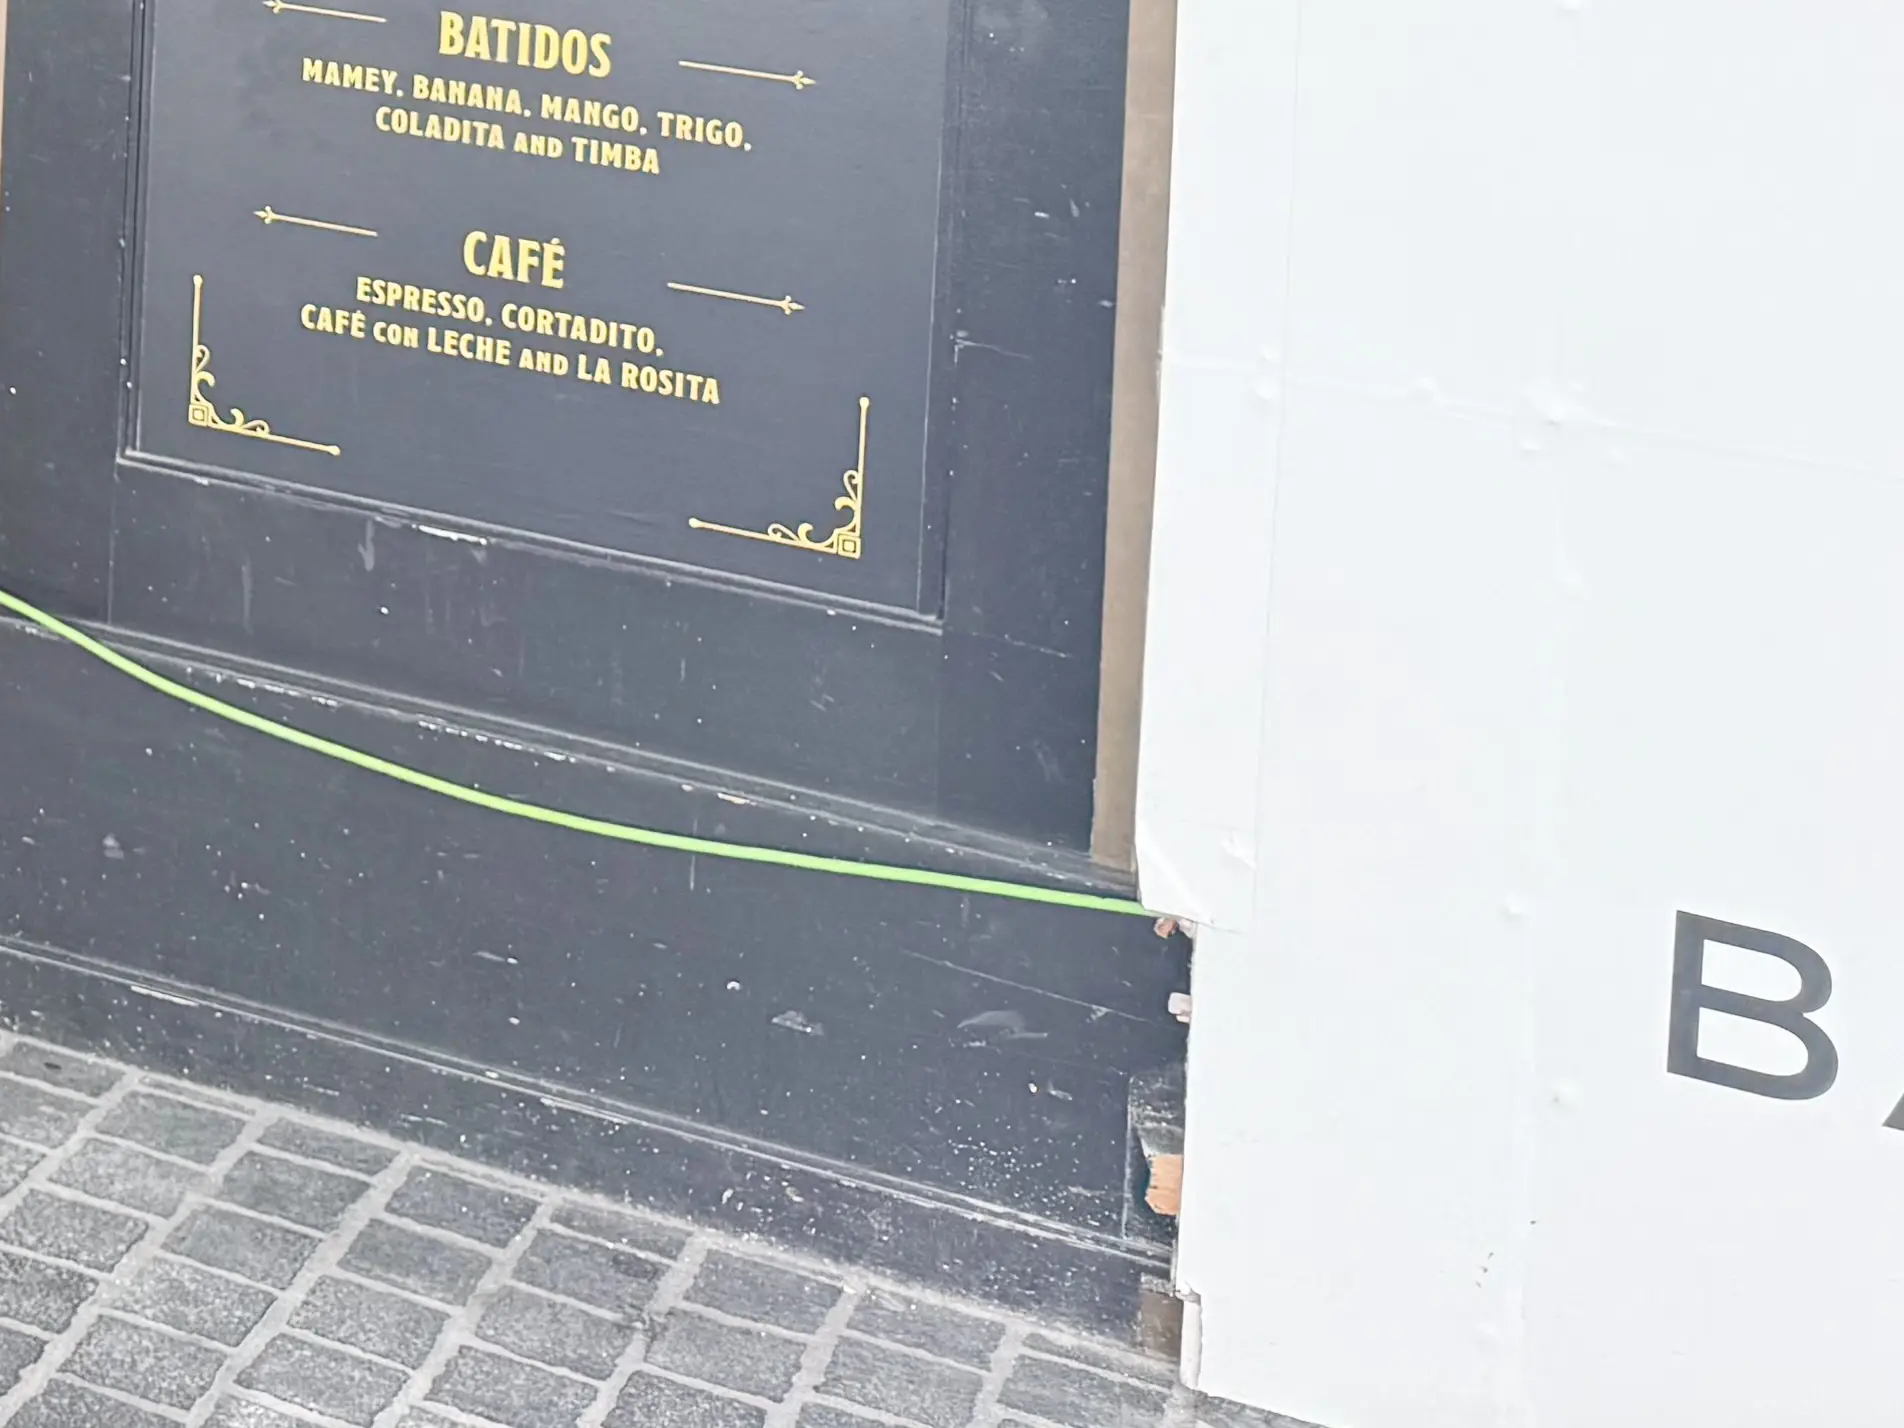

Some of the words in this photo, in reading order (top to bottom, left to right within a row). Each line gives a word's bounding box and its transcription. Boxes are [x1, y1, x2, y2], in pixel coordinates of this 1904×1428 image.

[437, 9, 612, 78] BATIDOS
[374, 105, 505, 150] COLADITA
[512, 130, 564, 159] AND
[570, 135, 660, 175] TIMBA
[462, 229, 566, 289] CAFÉ
[300, 302, 366, 339] CAFÉ
[372, 320, 419, 349] CON
[426, 325, 512, 366] LECHE
[517, 347, 569, 376] AND
[576, 352, 612, 385] LA
[620, 360, 721, 405] ROSITA
[1666, 909, 1904, 1131] B
